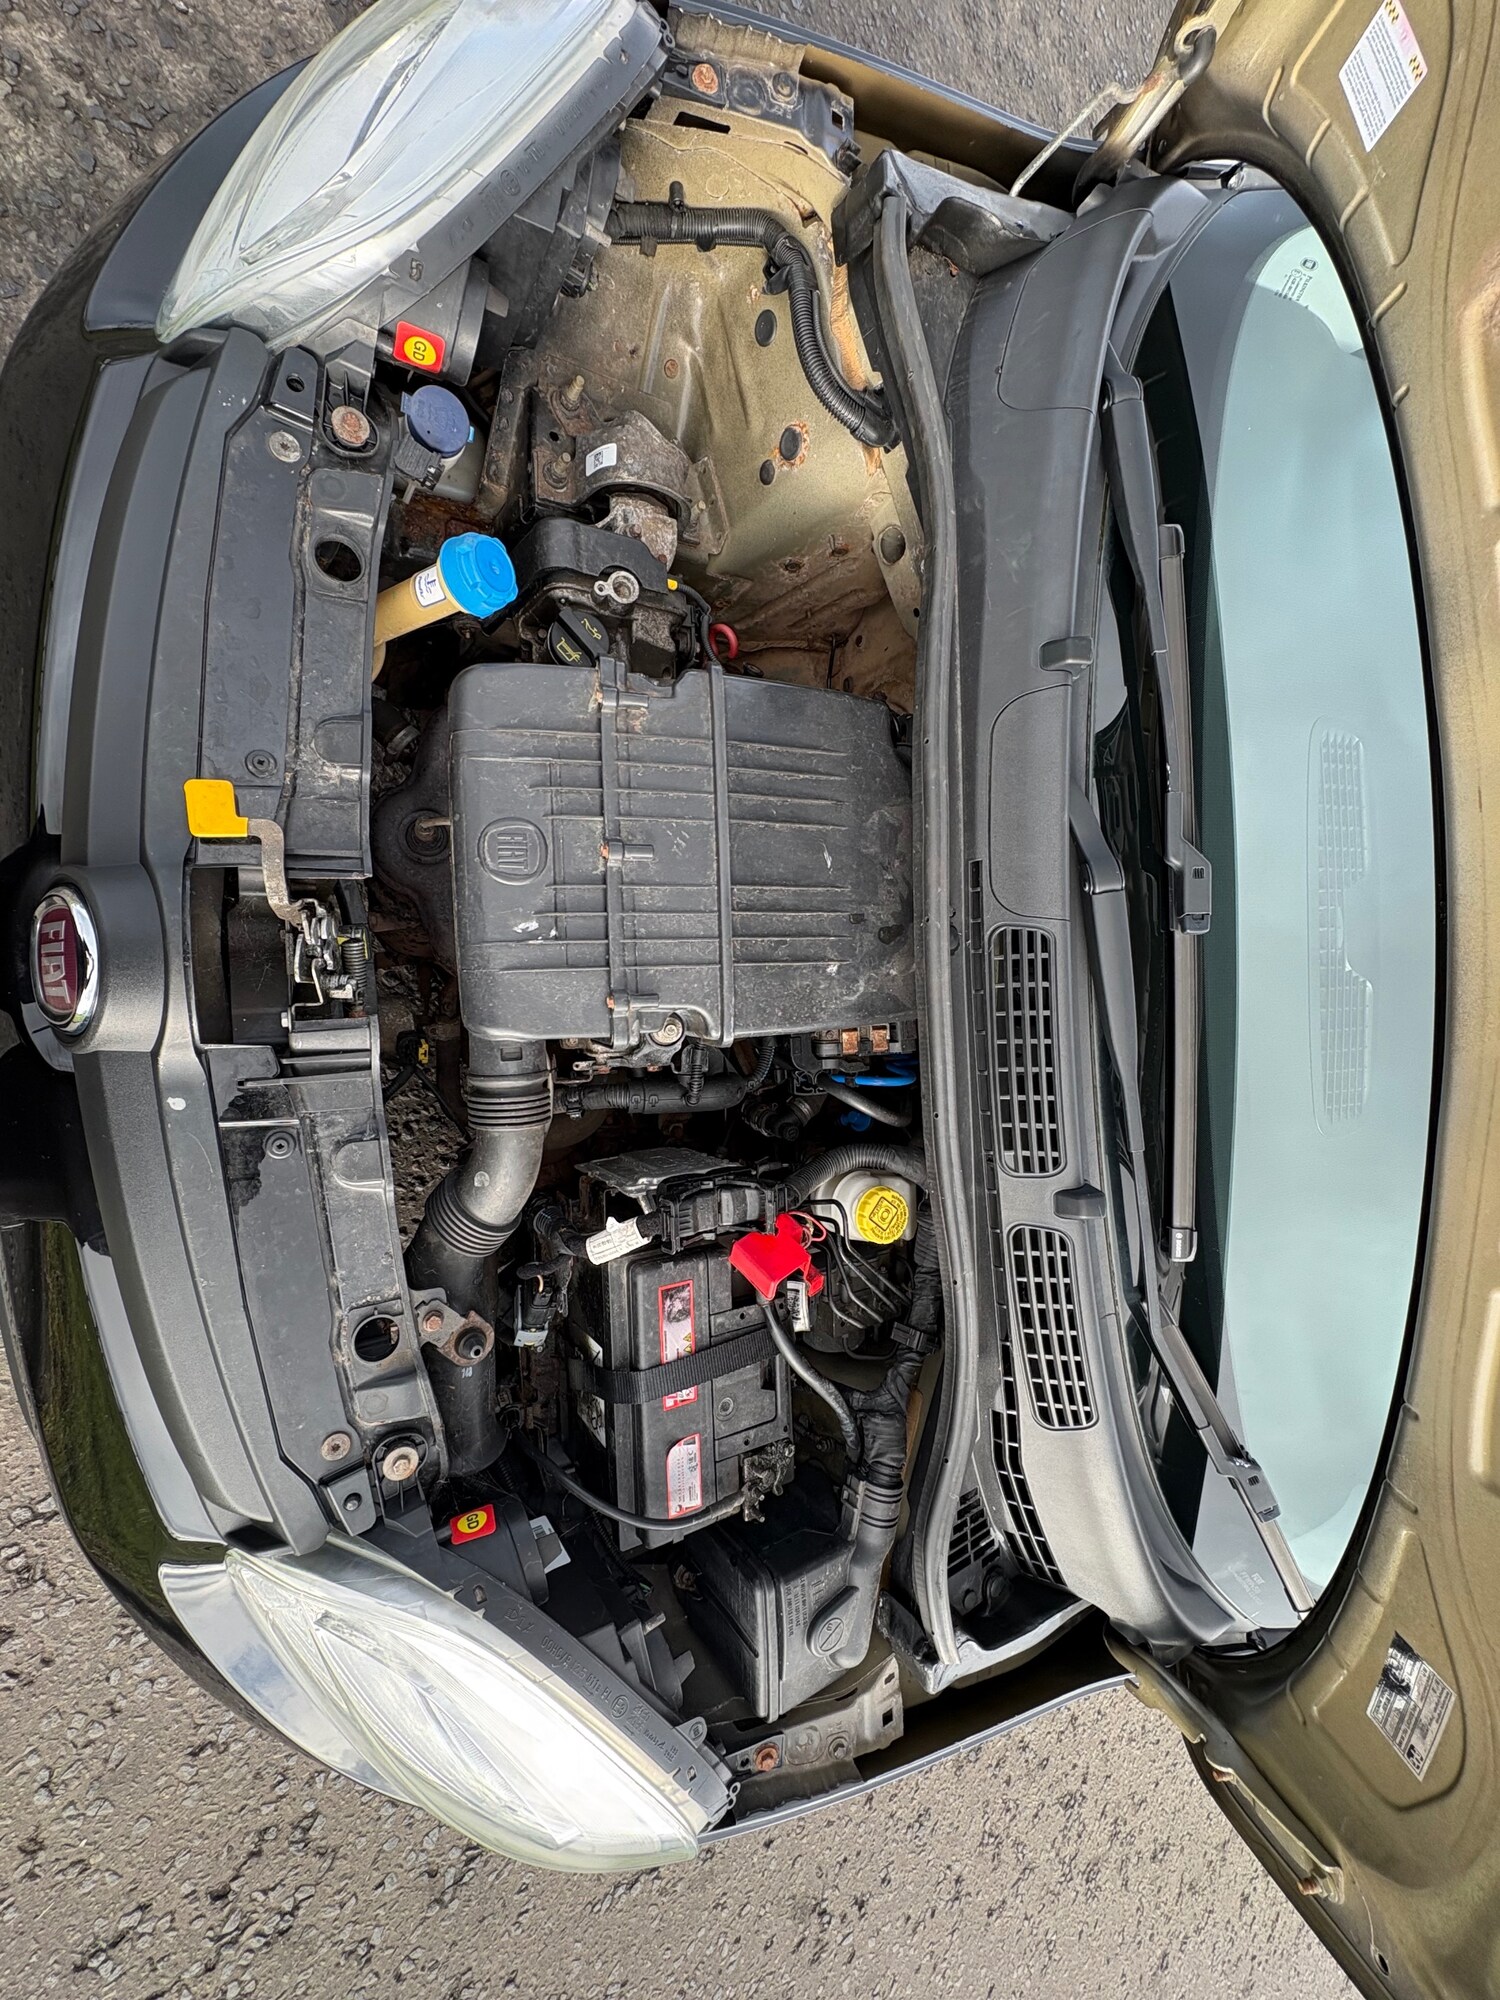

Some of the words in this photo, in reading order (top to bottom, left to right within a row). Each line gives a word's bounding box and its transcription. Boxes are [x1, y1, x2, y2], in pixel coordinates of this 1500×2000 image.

[412, 340, 427, 362] GD
[497, 832, 529, 872] FIAT
[41, 920, 71, 1004] FIAT
[466, 1513, 479, 1530] GD
